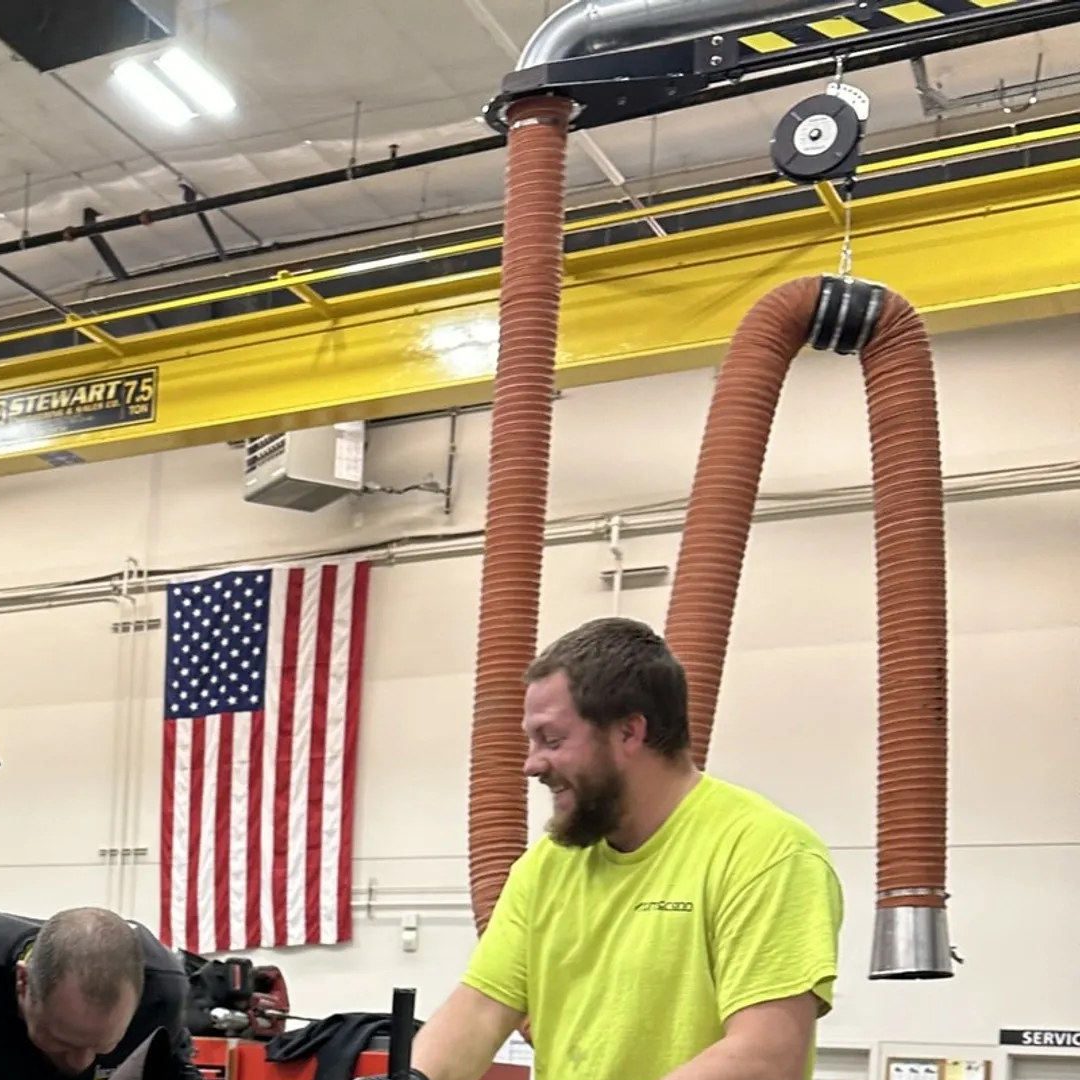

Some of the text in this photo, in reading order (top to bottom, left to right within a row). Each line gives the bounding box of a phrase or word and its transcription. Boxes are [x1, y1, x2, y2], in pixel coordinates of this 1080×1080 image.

[9, 380, 122, 417] STEWART
[128, 404, 149, 415] TON
[1022, 1031, 1080, 1046] SERVIC
